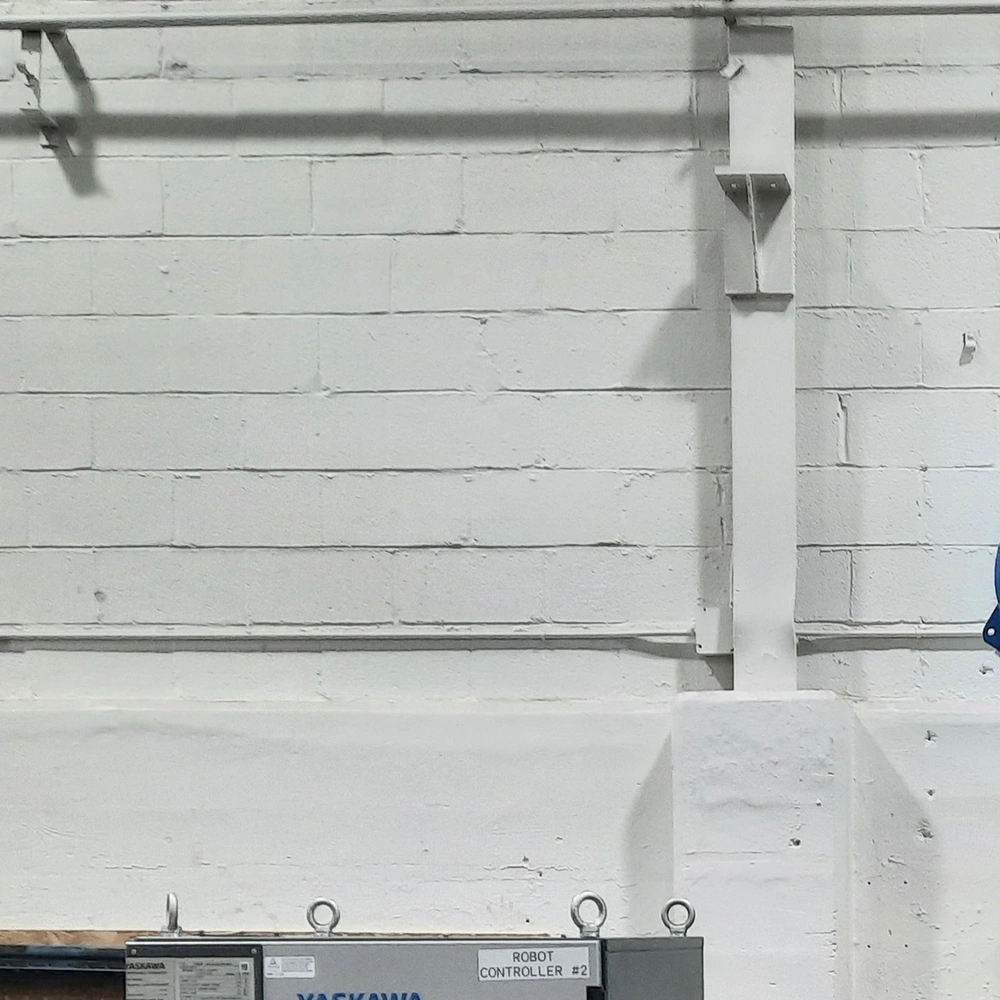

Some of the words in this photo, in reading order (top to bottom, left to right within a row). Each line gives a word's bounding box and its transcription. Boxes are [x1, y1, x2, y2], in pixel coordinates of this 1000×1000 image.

[512, 951, 554, 962] ROBOT
[480, 965, 563, 978] CONTROLLER
[572, 964, 588, 976] #2
